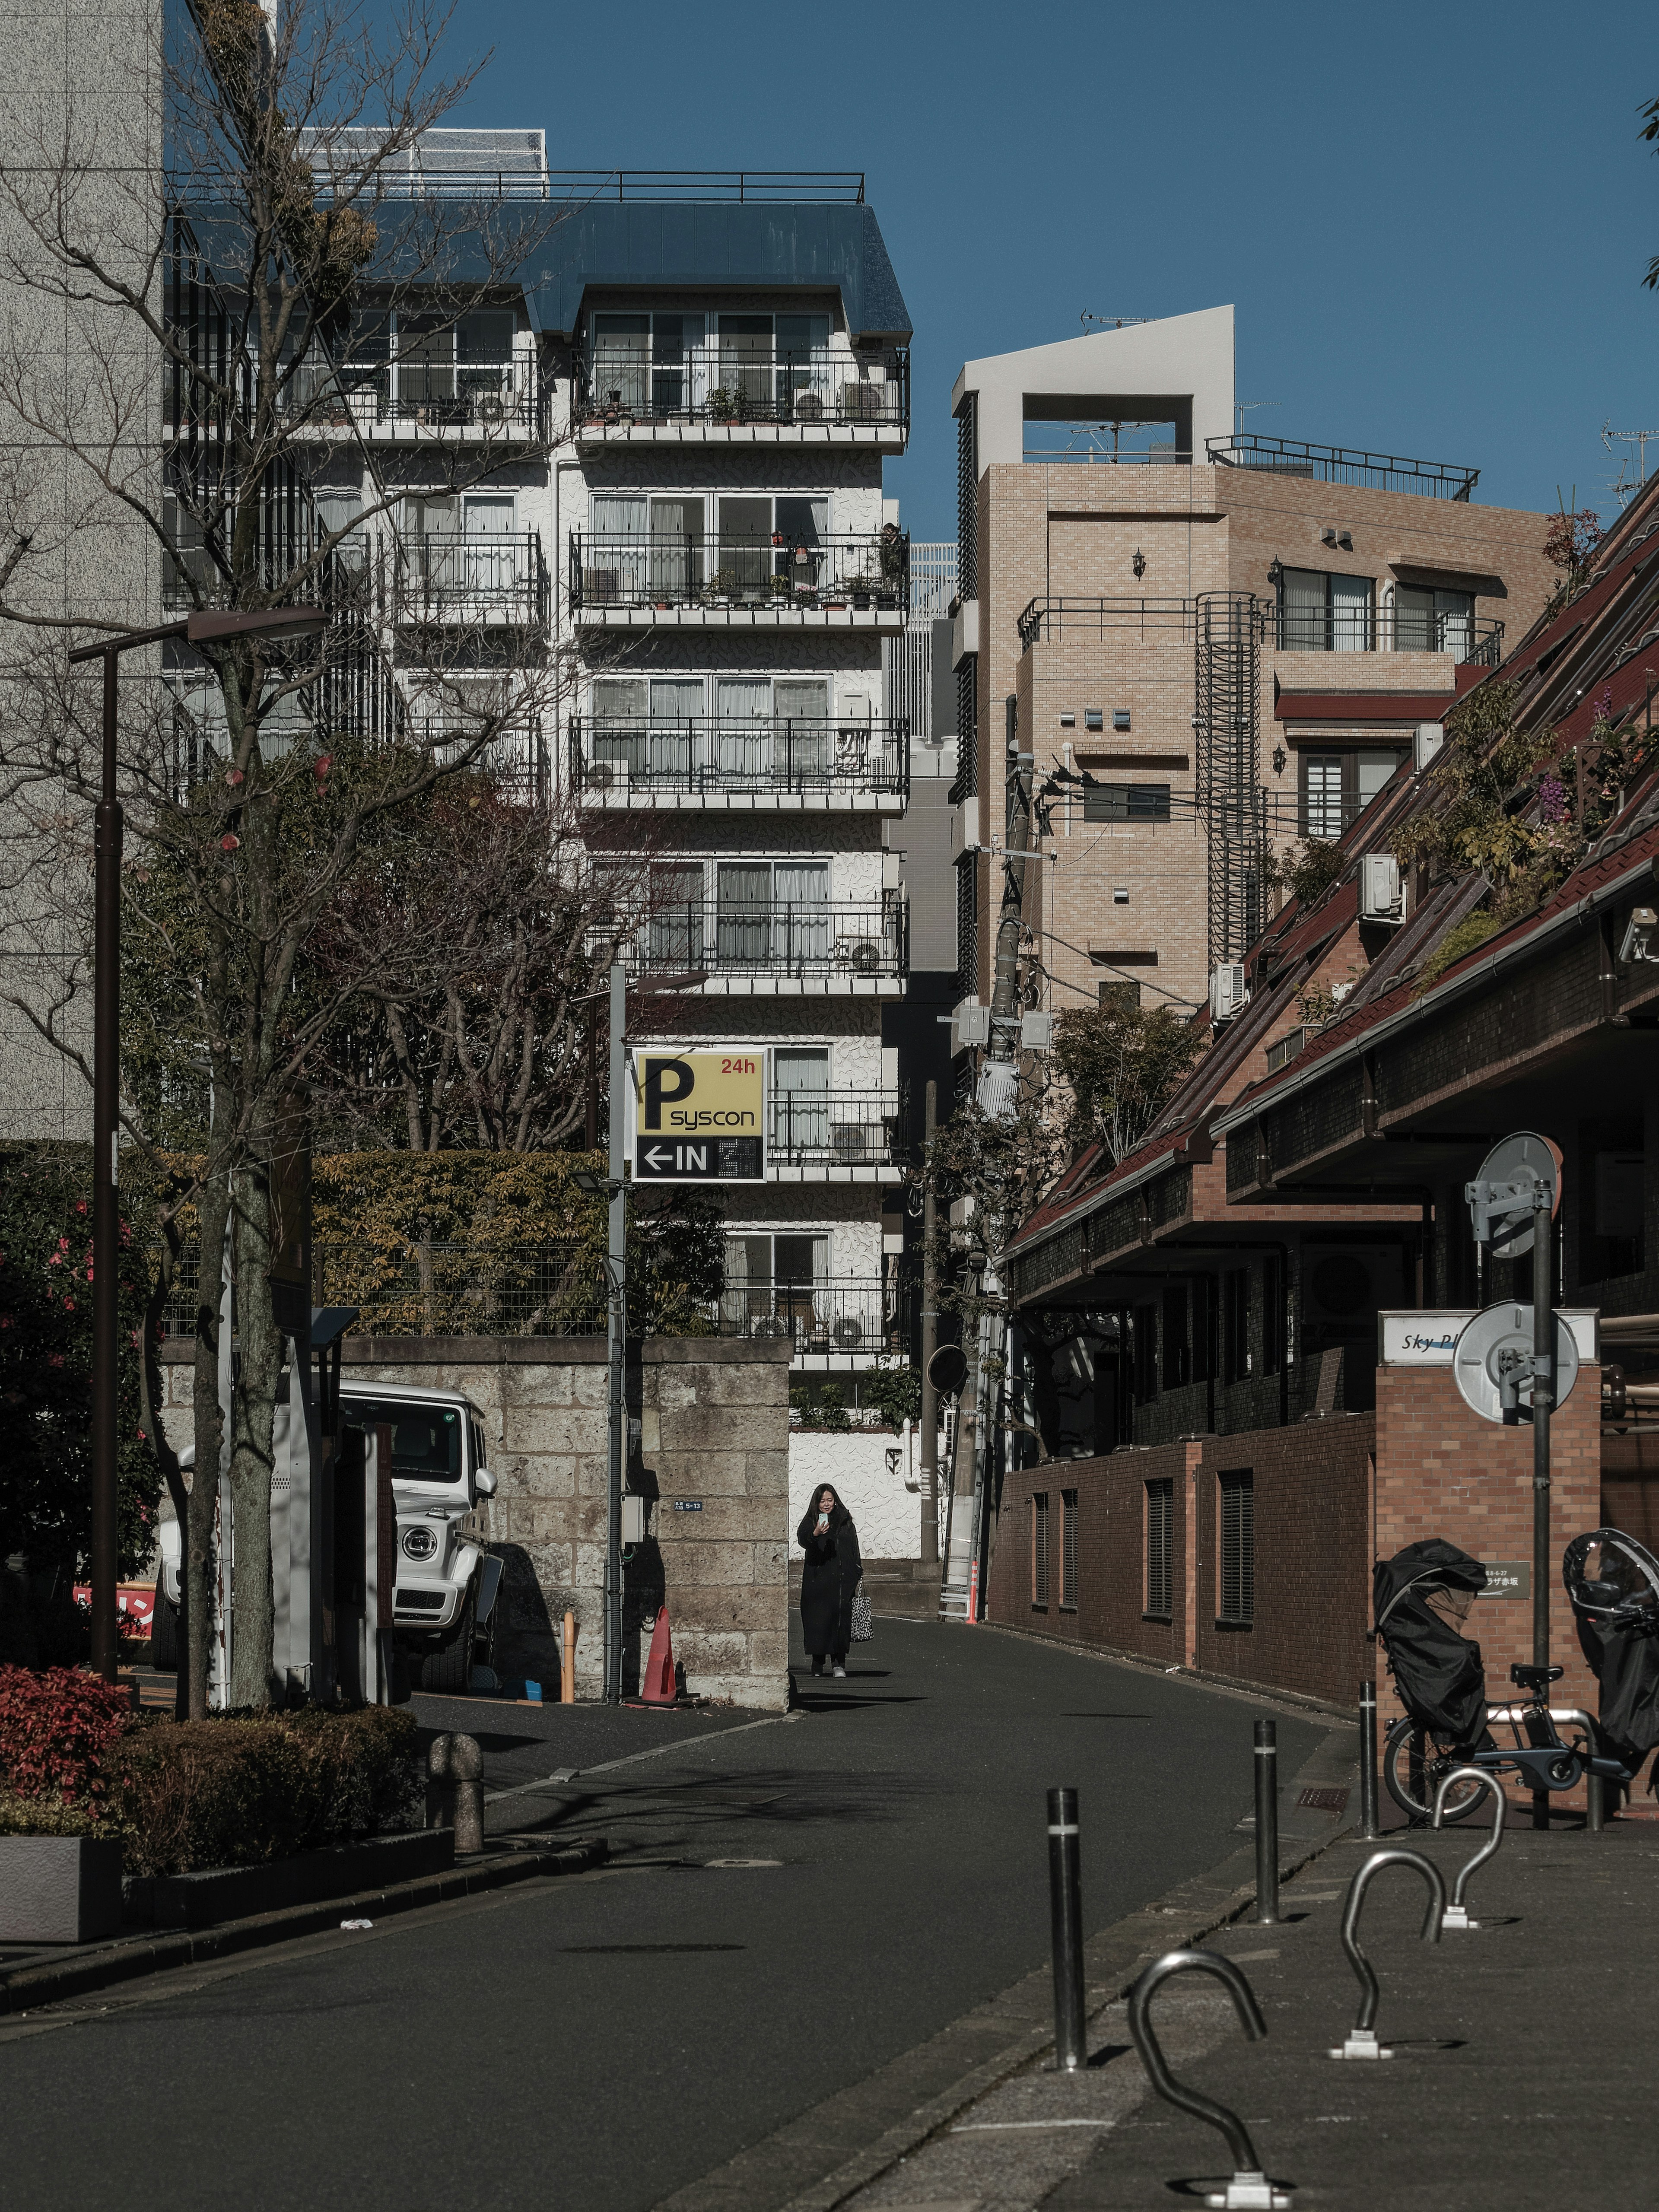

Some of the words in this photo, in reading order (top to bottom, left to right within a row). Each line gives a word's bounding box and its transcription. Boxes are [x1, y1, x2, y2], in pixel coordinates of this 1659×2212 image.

[721, 1059, 755, 1074] 24h
[645, 1058, 695, 1130] P
[670, 1111, 754, 1131] syscon
[677, 1146, 707, 1170] IN
[1402, 1334, 1434, 1353] Sky
